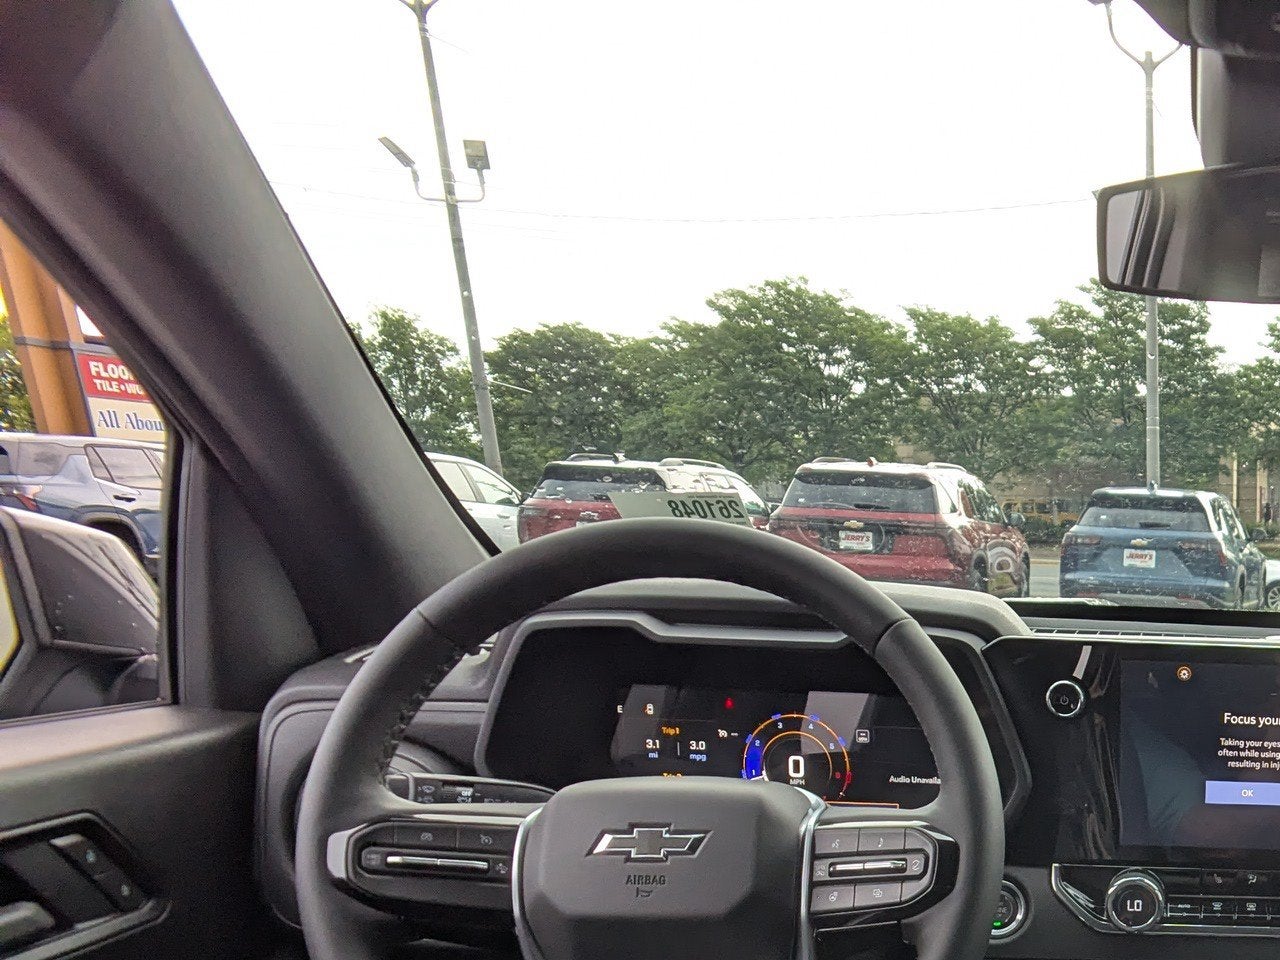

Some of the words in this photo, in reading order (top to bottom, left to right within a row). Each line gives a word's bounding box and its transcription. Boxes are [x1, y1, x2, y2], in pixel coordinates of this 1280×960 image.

[88, 361, 134, 380] FLOO
[97, 410, 120, 428] All
[617, 705, 623, 713] E
[1223, 712, 1256, 725] Focus
[646, 739, 660, 749] 3.1
[689, 740, 706, 750] 3.0
[1219, 737, 1245, 749] Taking
[1263, 741, 1280, 749] eyes
[648, 751, 659, 759] mi
[689, 753, 707, 762] mpg
[1217, 748, 1238, 757] often
[1239, 749, 1260, 758] while
[1260, 751, 1280, 760] using
[788, 755, 805, 778] 0
[1227, 760, 1261, 770] resulting
[1261, 760, 1269, 769] in
[889, 775, 910, 783] Audio
[1241, 789, 1254, 798] OK
[626, 875, 666, 885] AIRBAG
[1127, 900, 1142, 912] LO
